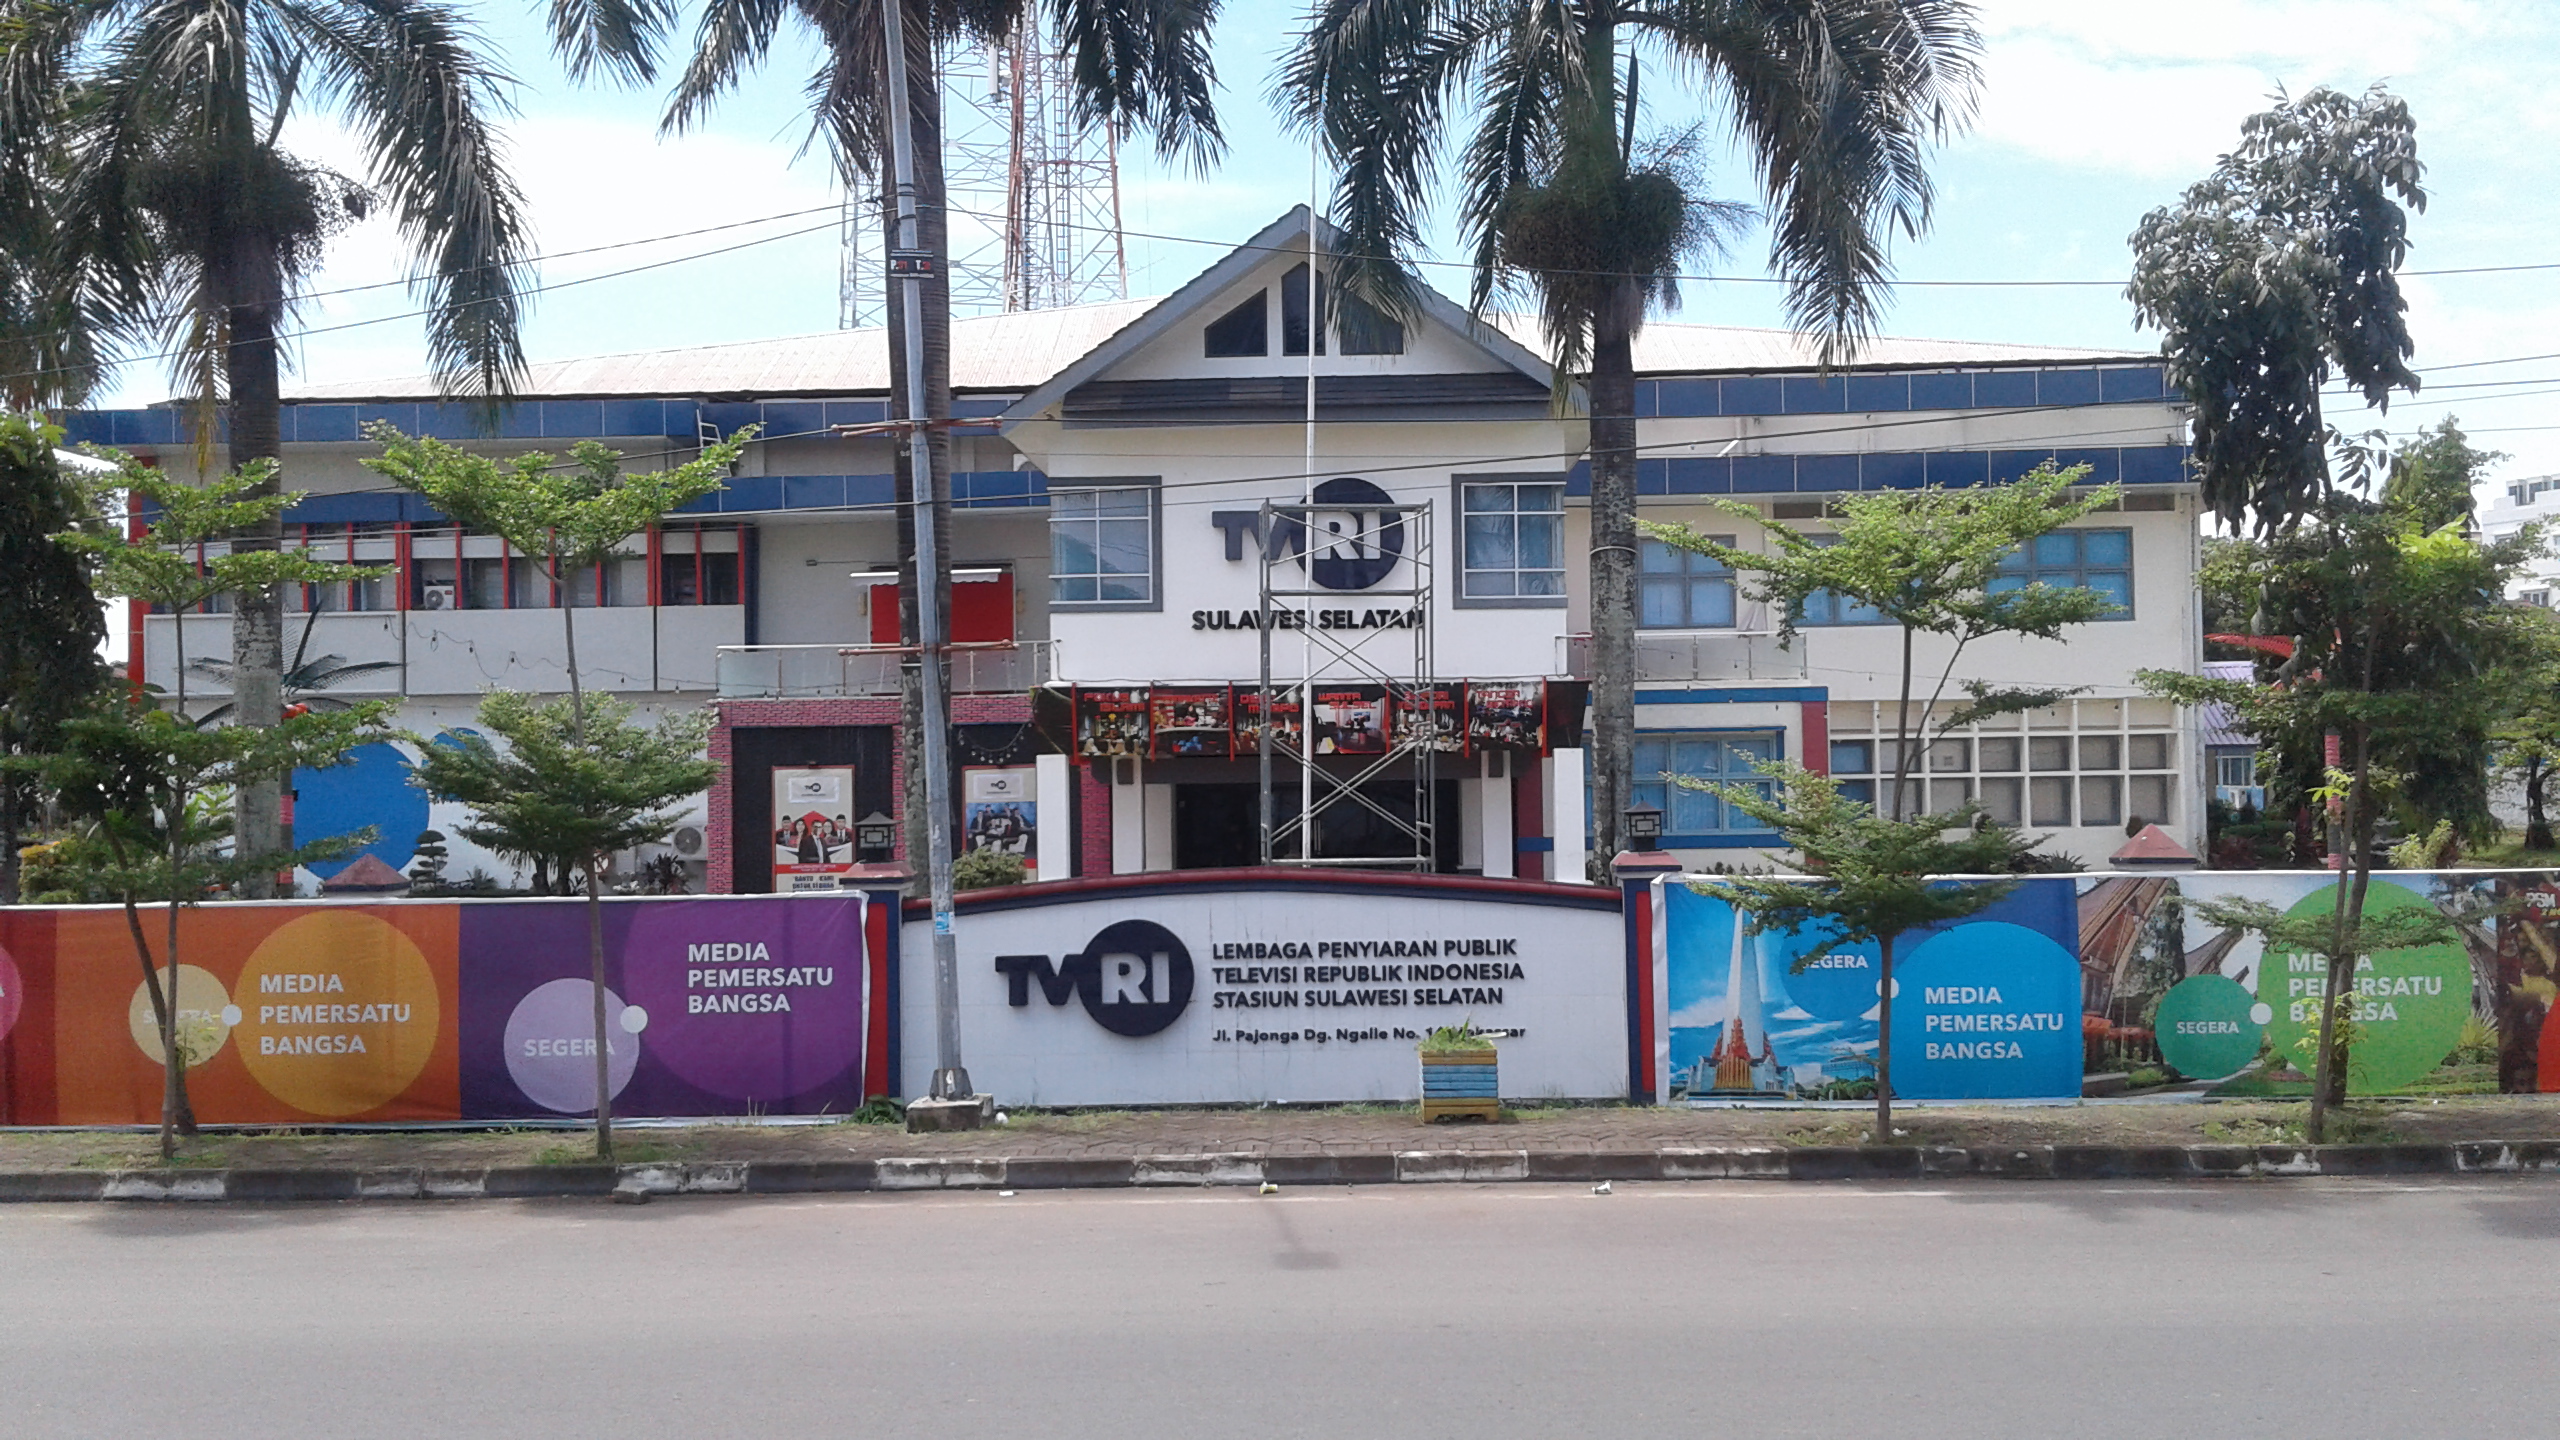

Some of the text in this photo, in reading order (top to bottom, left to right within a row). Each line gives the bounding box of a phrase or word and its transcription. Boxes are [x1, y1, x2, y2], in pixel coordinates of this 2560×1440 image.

[1318, 609, 1424, 630] SELATAN
[688, 942, 770, 963] MEDIA
[1212, 938, 1517, 960] LEMBAGA PENYIARAN PUBLIK
[2288, 952, 2374, 972] MEA
[688, 967, 834, 988] PEMERSATU
[1212, 962, 1525, 984] TELEVISI REPUBLIK INDONESIA
[260, 974, 345, 994] MEDIA
[2288, 976, 2442, 997] PERSATU
[688, 994, 791, 1014] BANGSA
[1212, 987, 1504, 1008] STASIUN SULAWESI SELATAN
[1925, 986, 2003, 1005] MEDIA
[143, 1008, 213, 1024] SERA
[260, 1004, 411, 1025] PEMERSATU
[2290, 1002, 2398, 1021] BAGSA
[1925, 1012, 2064, 1033] PEMERSATU
[2176, 1020, 2240, 1035] SEGERA
[260, 1035, 367, 1055] BANGSA
[1212, 1029, 1231, 1042] Jl.
[1236, 1029, 1299, 1045] Pajonga
[1304, 1028, 1332, 1044] Dg.
[1336, 1027, 1388, 1044] Ngalle
[1393, 1026, 1421, 1040] No.
[524, 1038, 615, 1056] SEGERA
[1925, 1041, 2024, 1060] BANGSA
